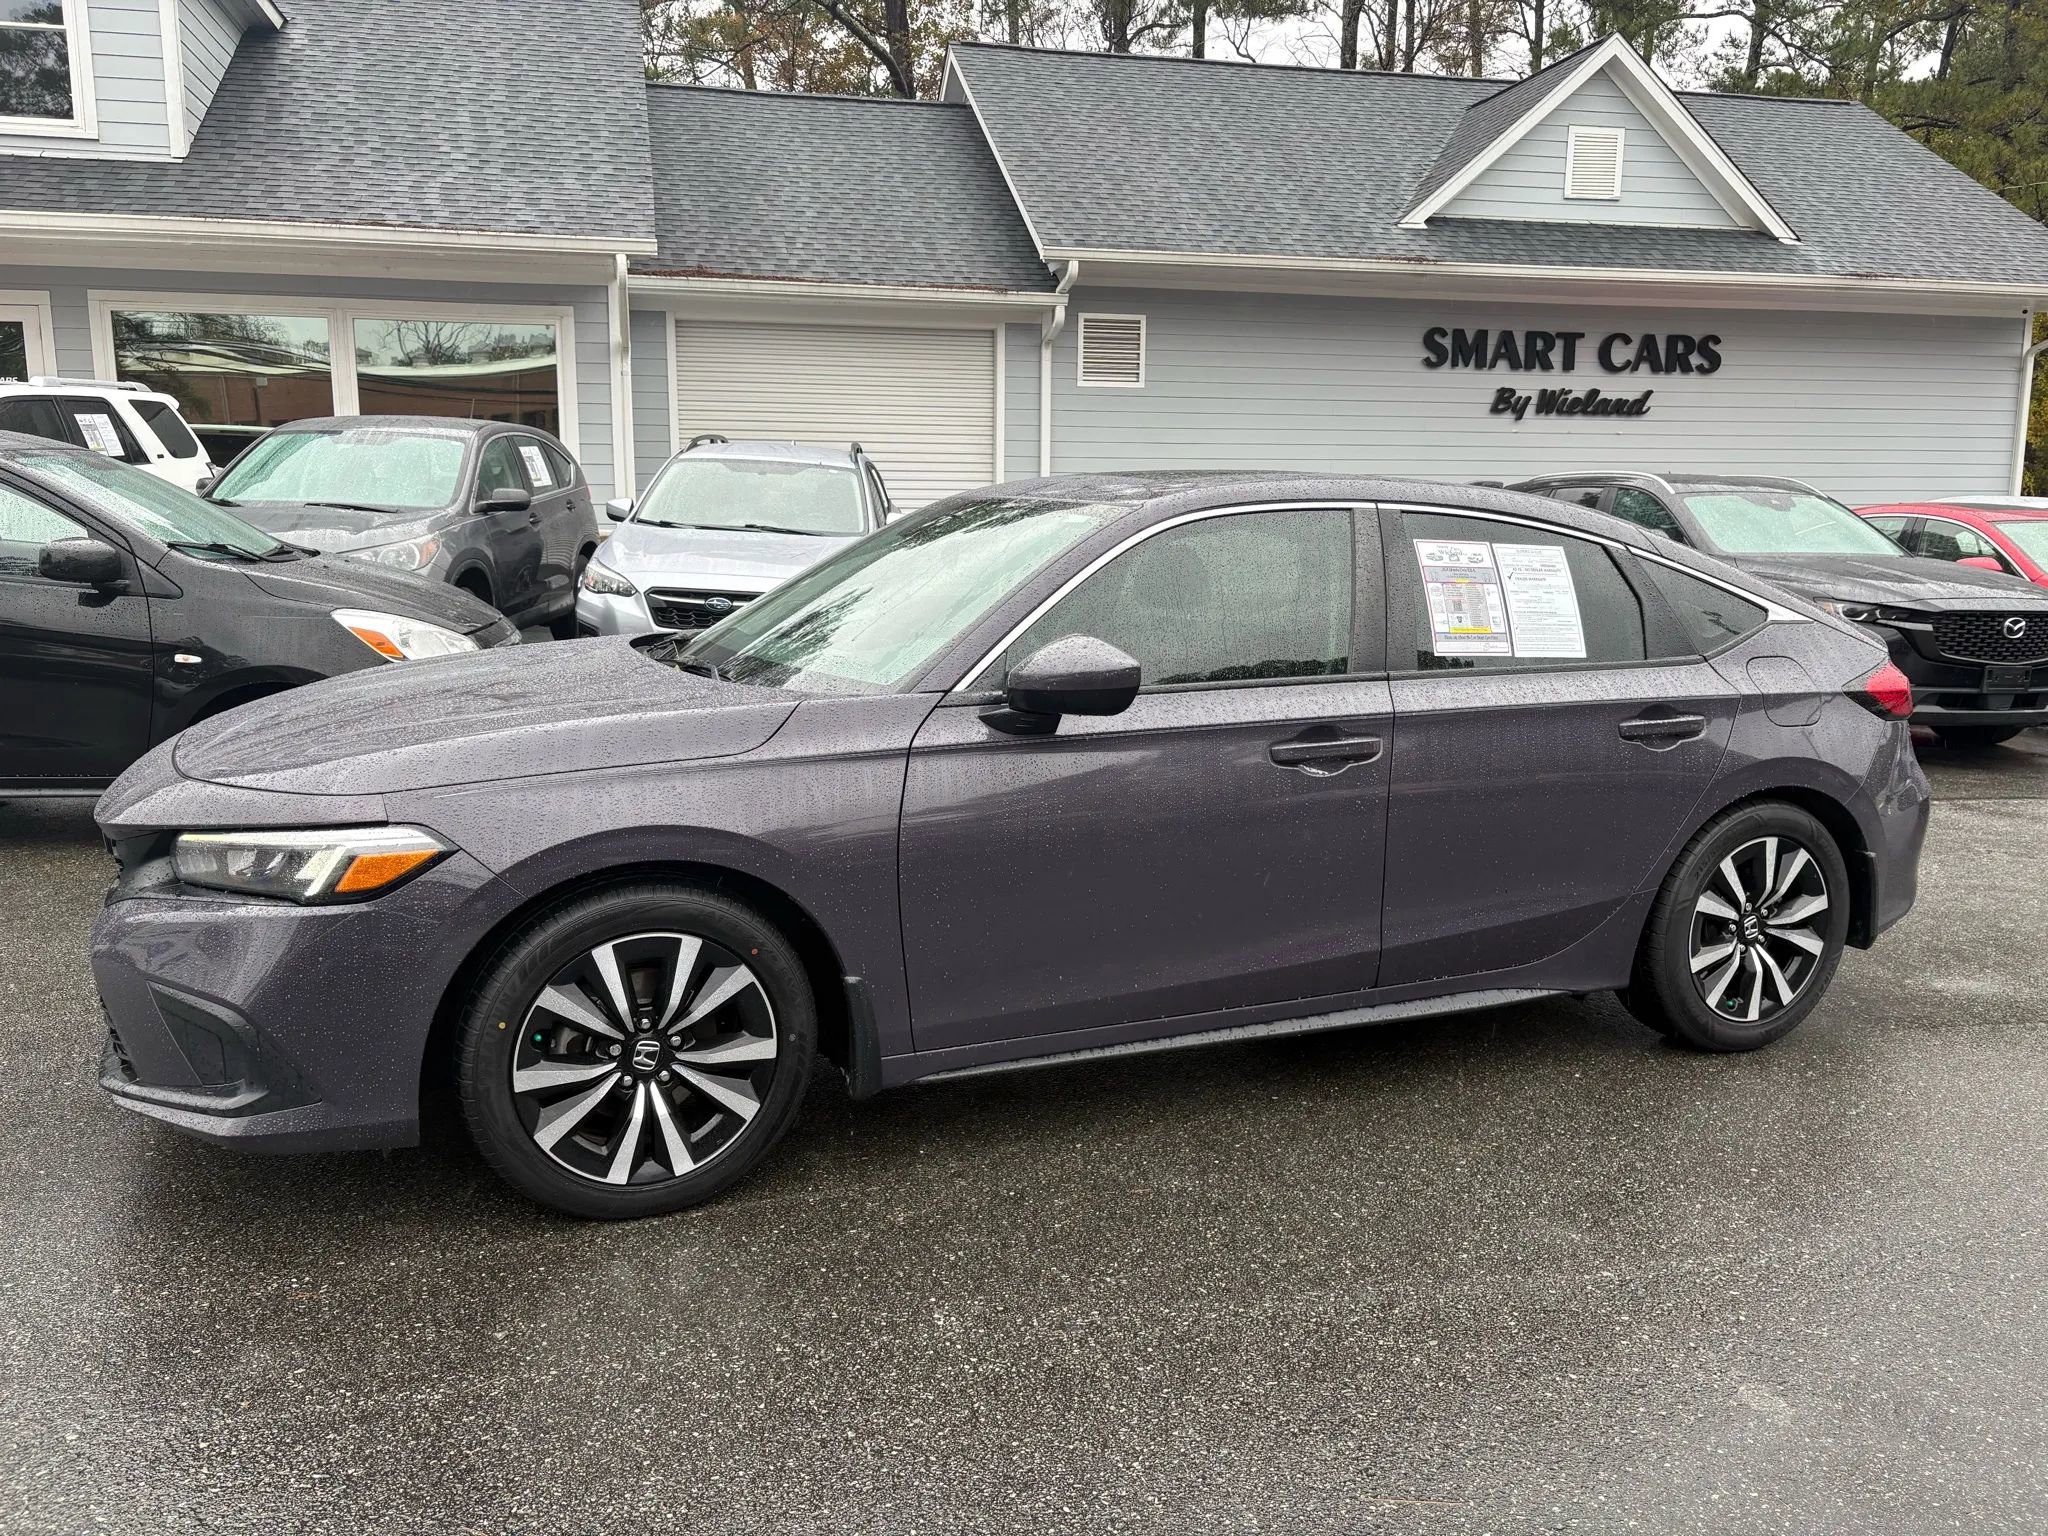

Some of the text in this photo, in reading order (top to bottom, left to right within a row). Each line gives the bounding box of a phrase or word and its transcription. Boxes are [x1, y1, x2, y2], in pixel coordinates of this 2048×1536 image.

[1423, 326, 1722, 374] SMART CARS
[1490, 387, 1654, 421] By Wieland
